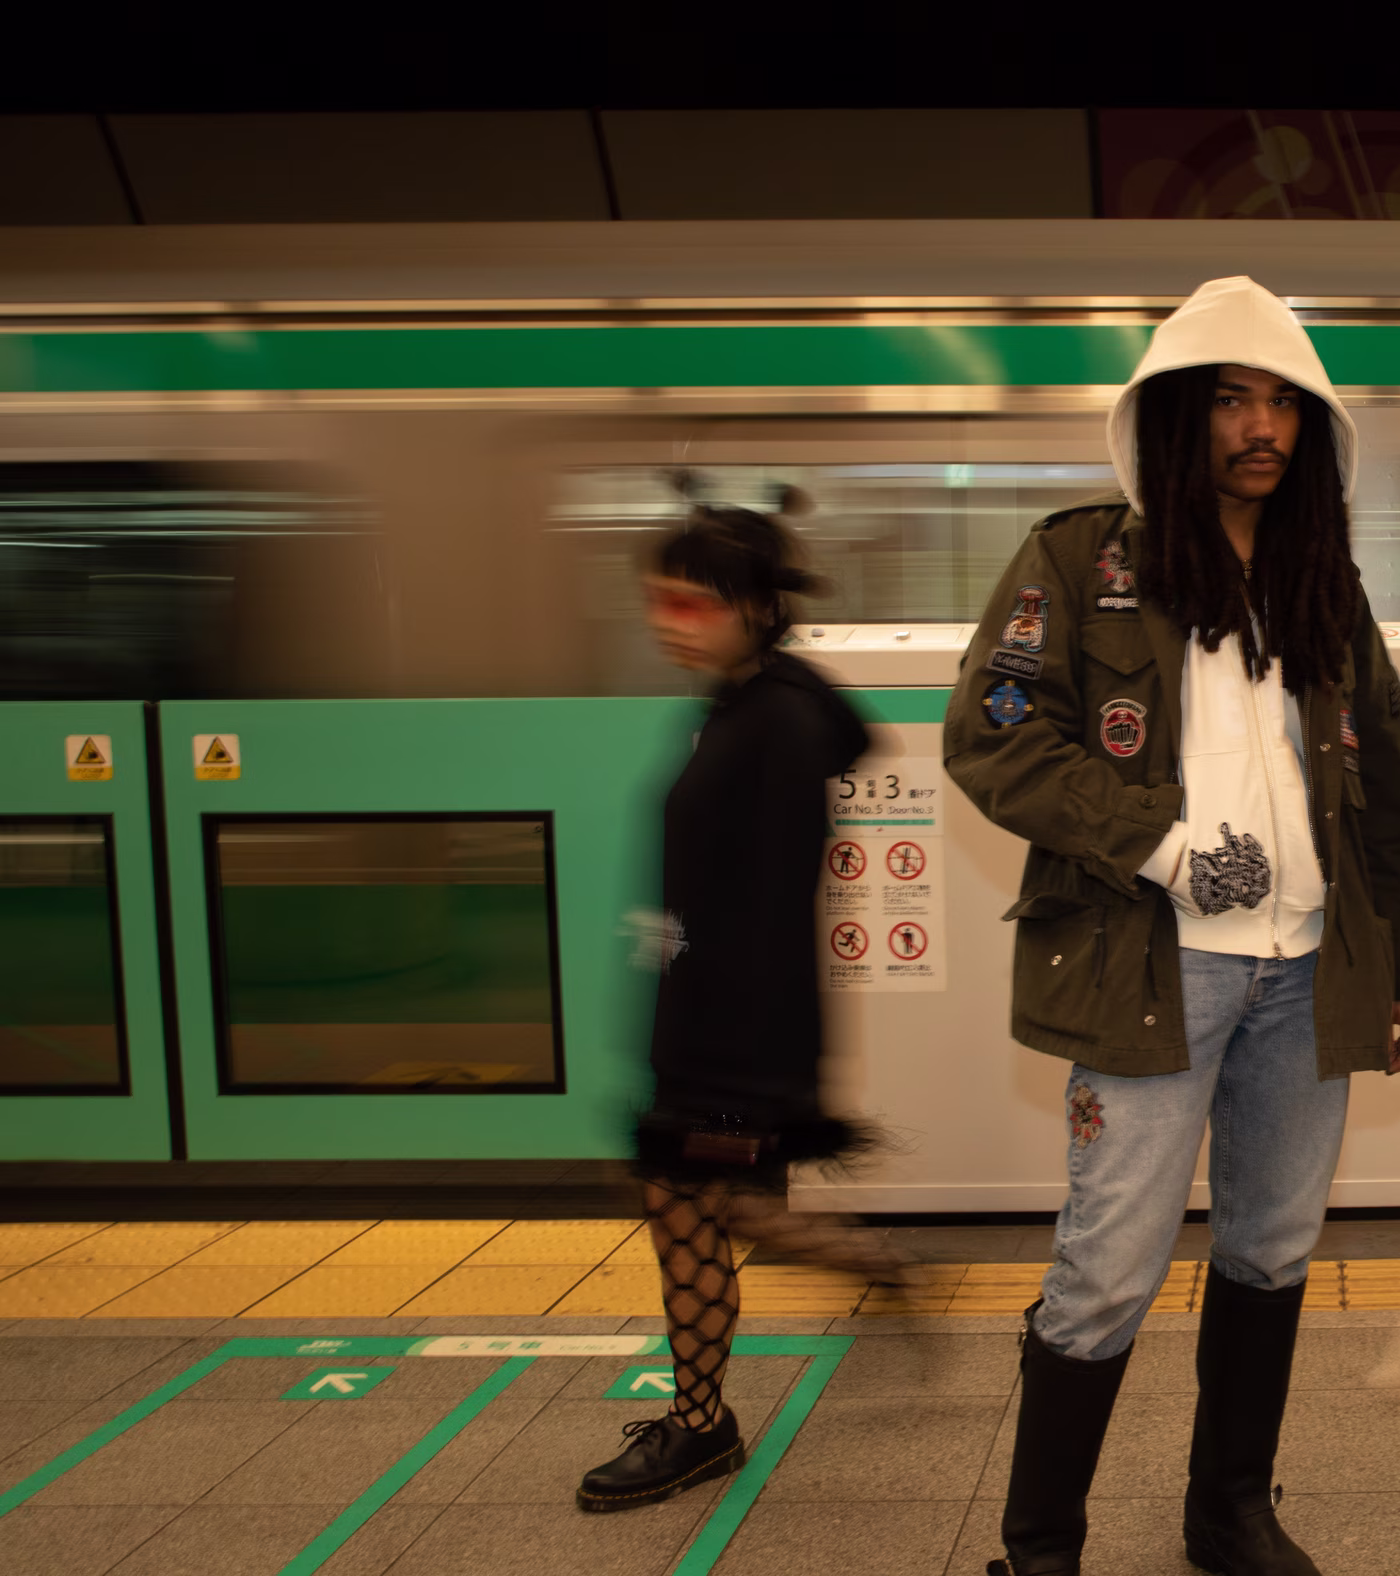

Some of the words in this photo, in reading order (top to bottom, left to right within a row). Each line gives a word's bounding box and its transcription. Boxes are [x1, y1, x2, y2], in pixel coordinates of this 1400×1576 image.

[838, 769, 857, 799] 5
[884, 774, 900, 799] 3
[833, 804, 852, 814] Car
[888, 806, 911, 814] Door
